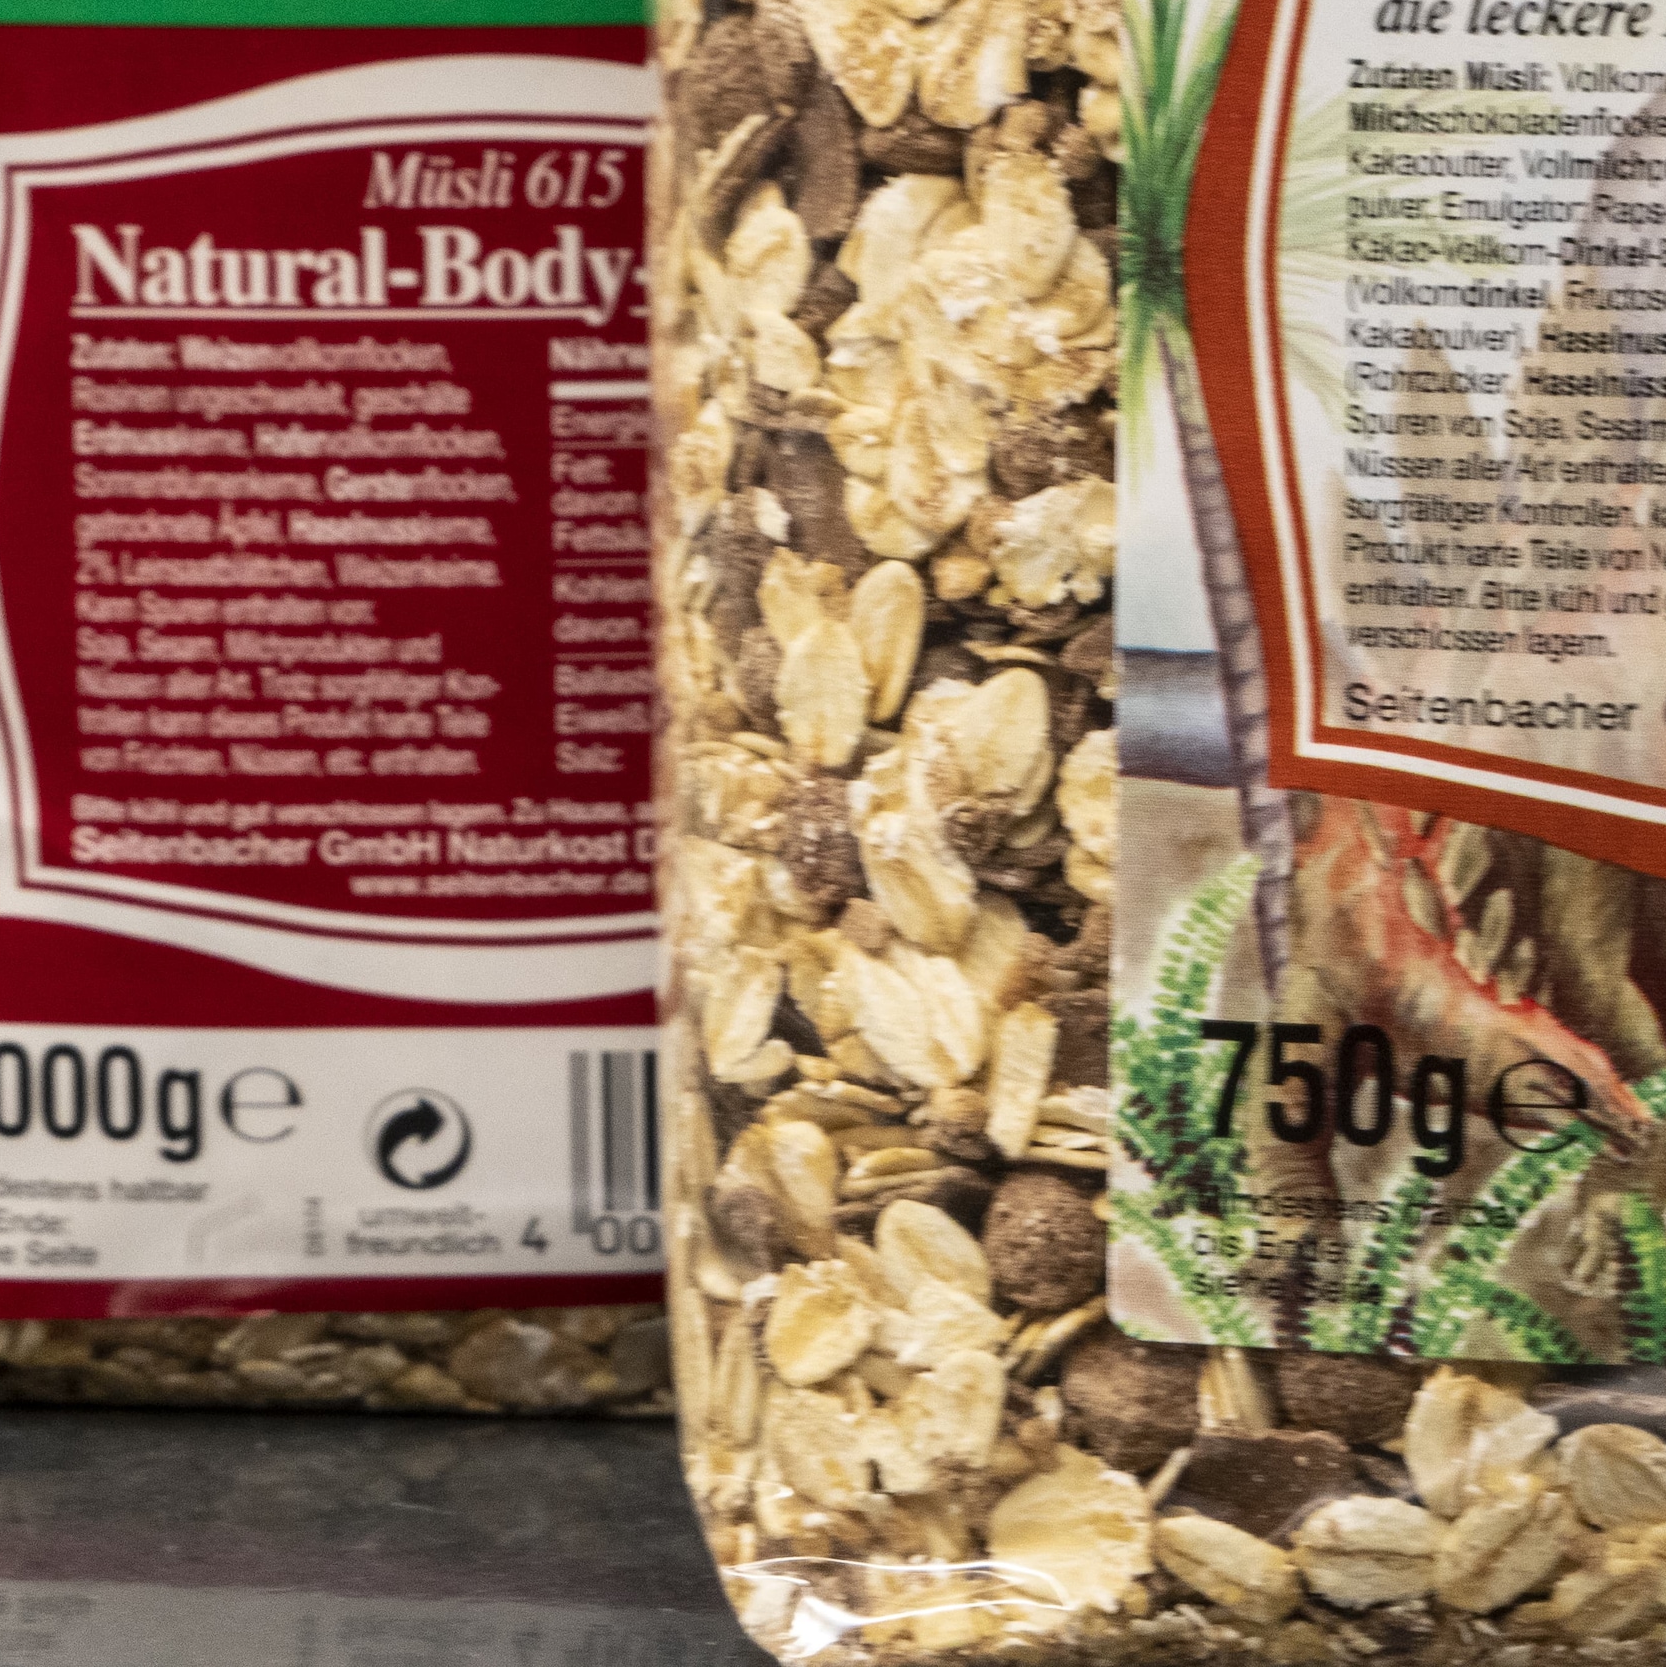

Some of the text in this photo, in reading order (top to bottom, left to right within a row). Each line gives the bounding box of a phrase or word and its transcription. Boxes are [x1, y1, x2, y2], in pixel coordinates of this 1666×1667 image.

[1347, 58, 1457, 90] Zutaten
[362, 148, 630, 210] Müsli 615
[1342, 682, 1640, 736] Seitenbacher
[1198, 1017, 1468, 1178] 750g
[24, 1239, 100, 1269] Seite
[344, 1230, 503, 1258] freundlich
